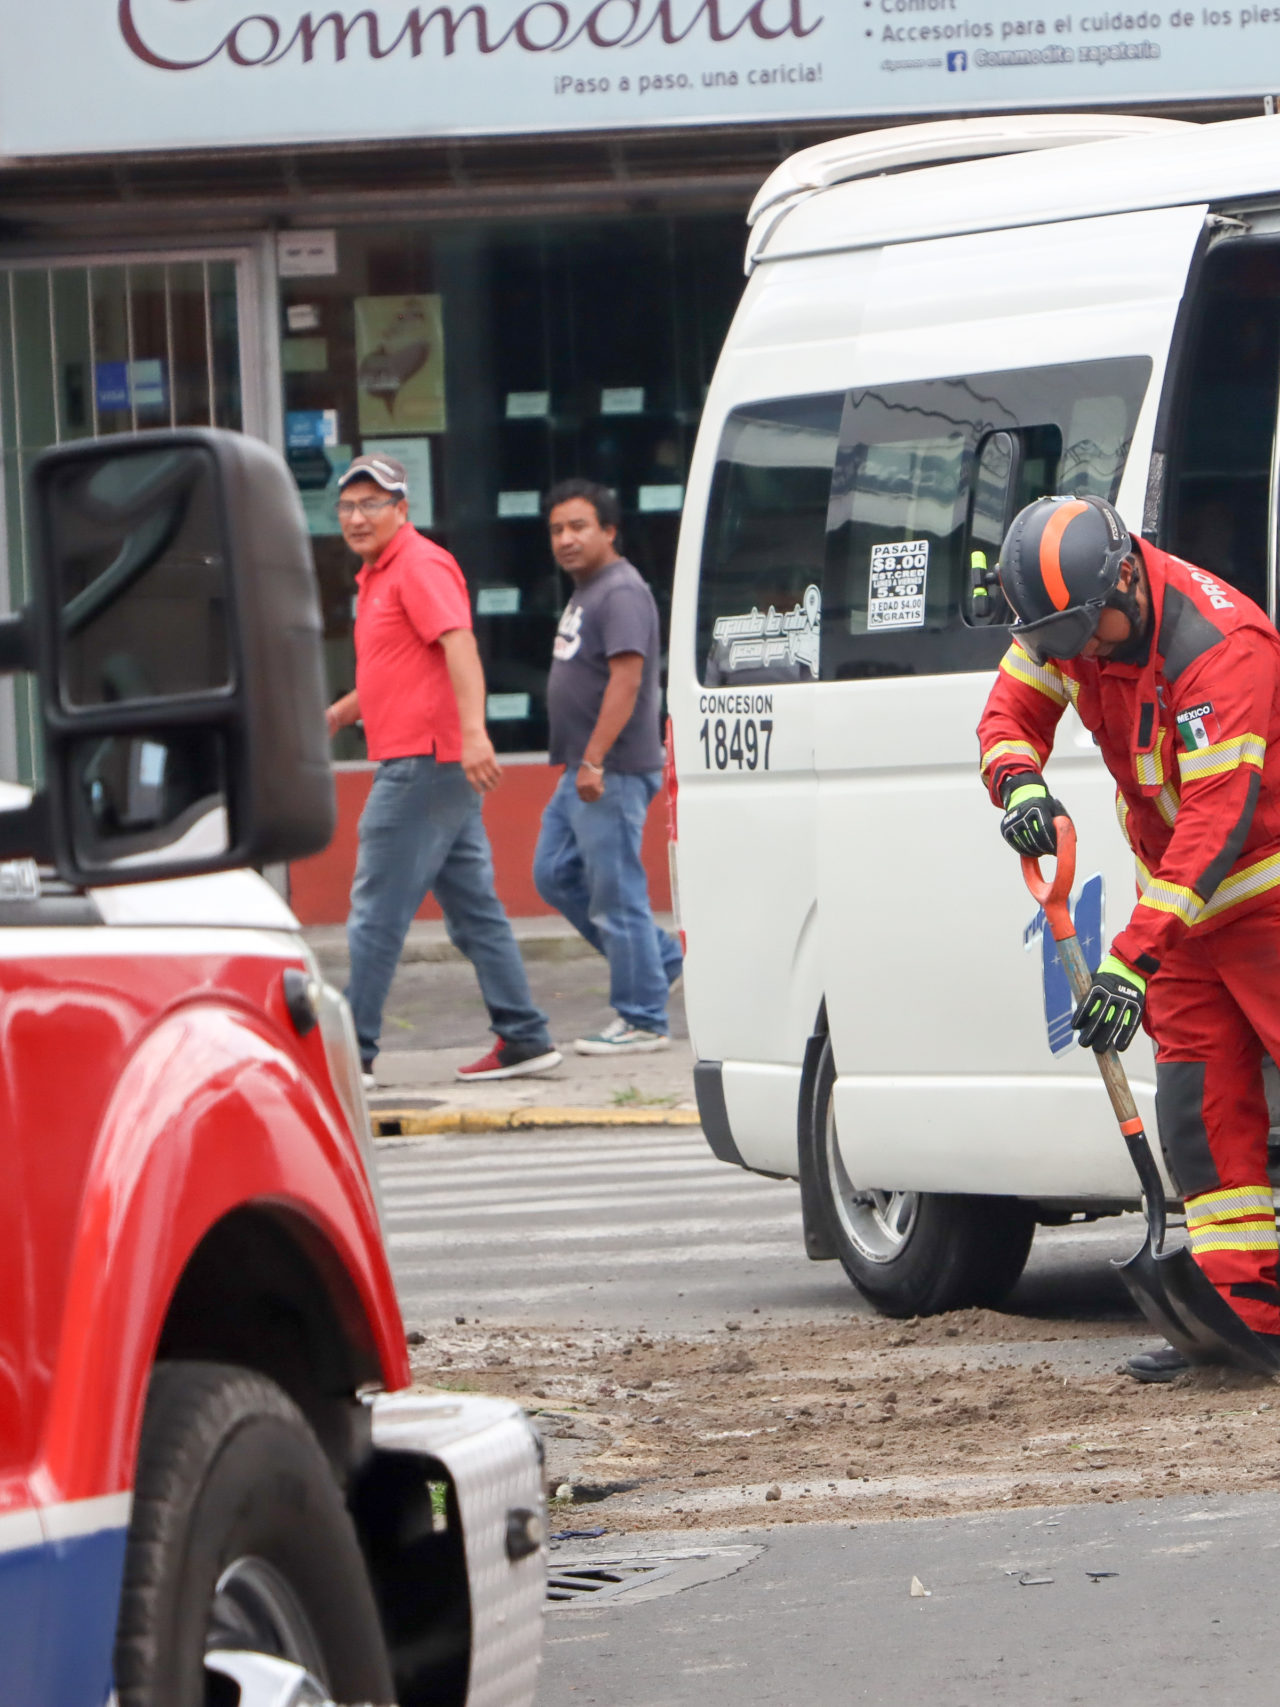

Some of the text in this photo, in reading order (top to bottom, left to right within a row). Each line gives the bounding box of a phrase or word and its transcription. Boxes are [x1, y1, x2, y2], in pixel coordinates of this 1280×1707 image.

[881, 21, 994, 42] Accesorios
[1002, 19, 1046, 41] para
[1054, 15, 1072, 33] el
[1079, 11, 1162, 32] cuidado
[1169, 9, 1195, 28] de
[1202, 7, 1232, 26] los
[554, 74, 610, 95] ¡Paso
[618, 76, 630, 92] a
[702, 69, 739, 88] una
[748, 62, 824, 85] caricia!
[874, 542, 926, 556] PASAJE
[872, 554, 926, 573] $8.00
[877, 585, 918, 598] 5.50
[878, 601, 899, 612] EDAD
[901, 599, 921, 610] $4.00
[883, 610, 921, 622] GRATIS
[700, 694, 773, 714] CONCESION
[1177, 704, 1212, 724] MÉXICO
[700, 718, 773, 771] 18497
